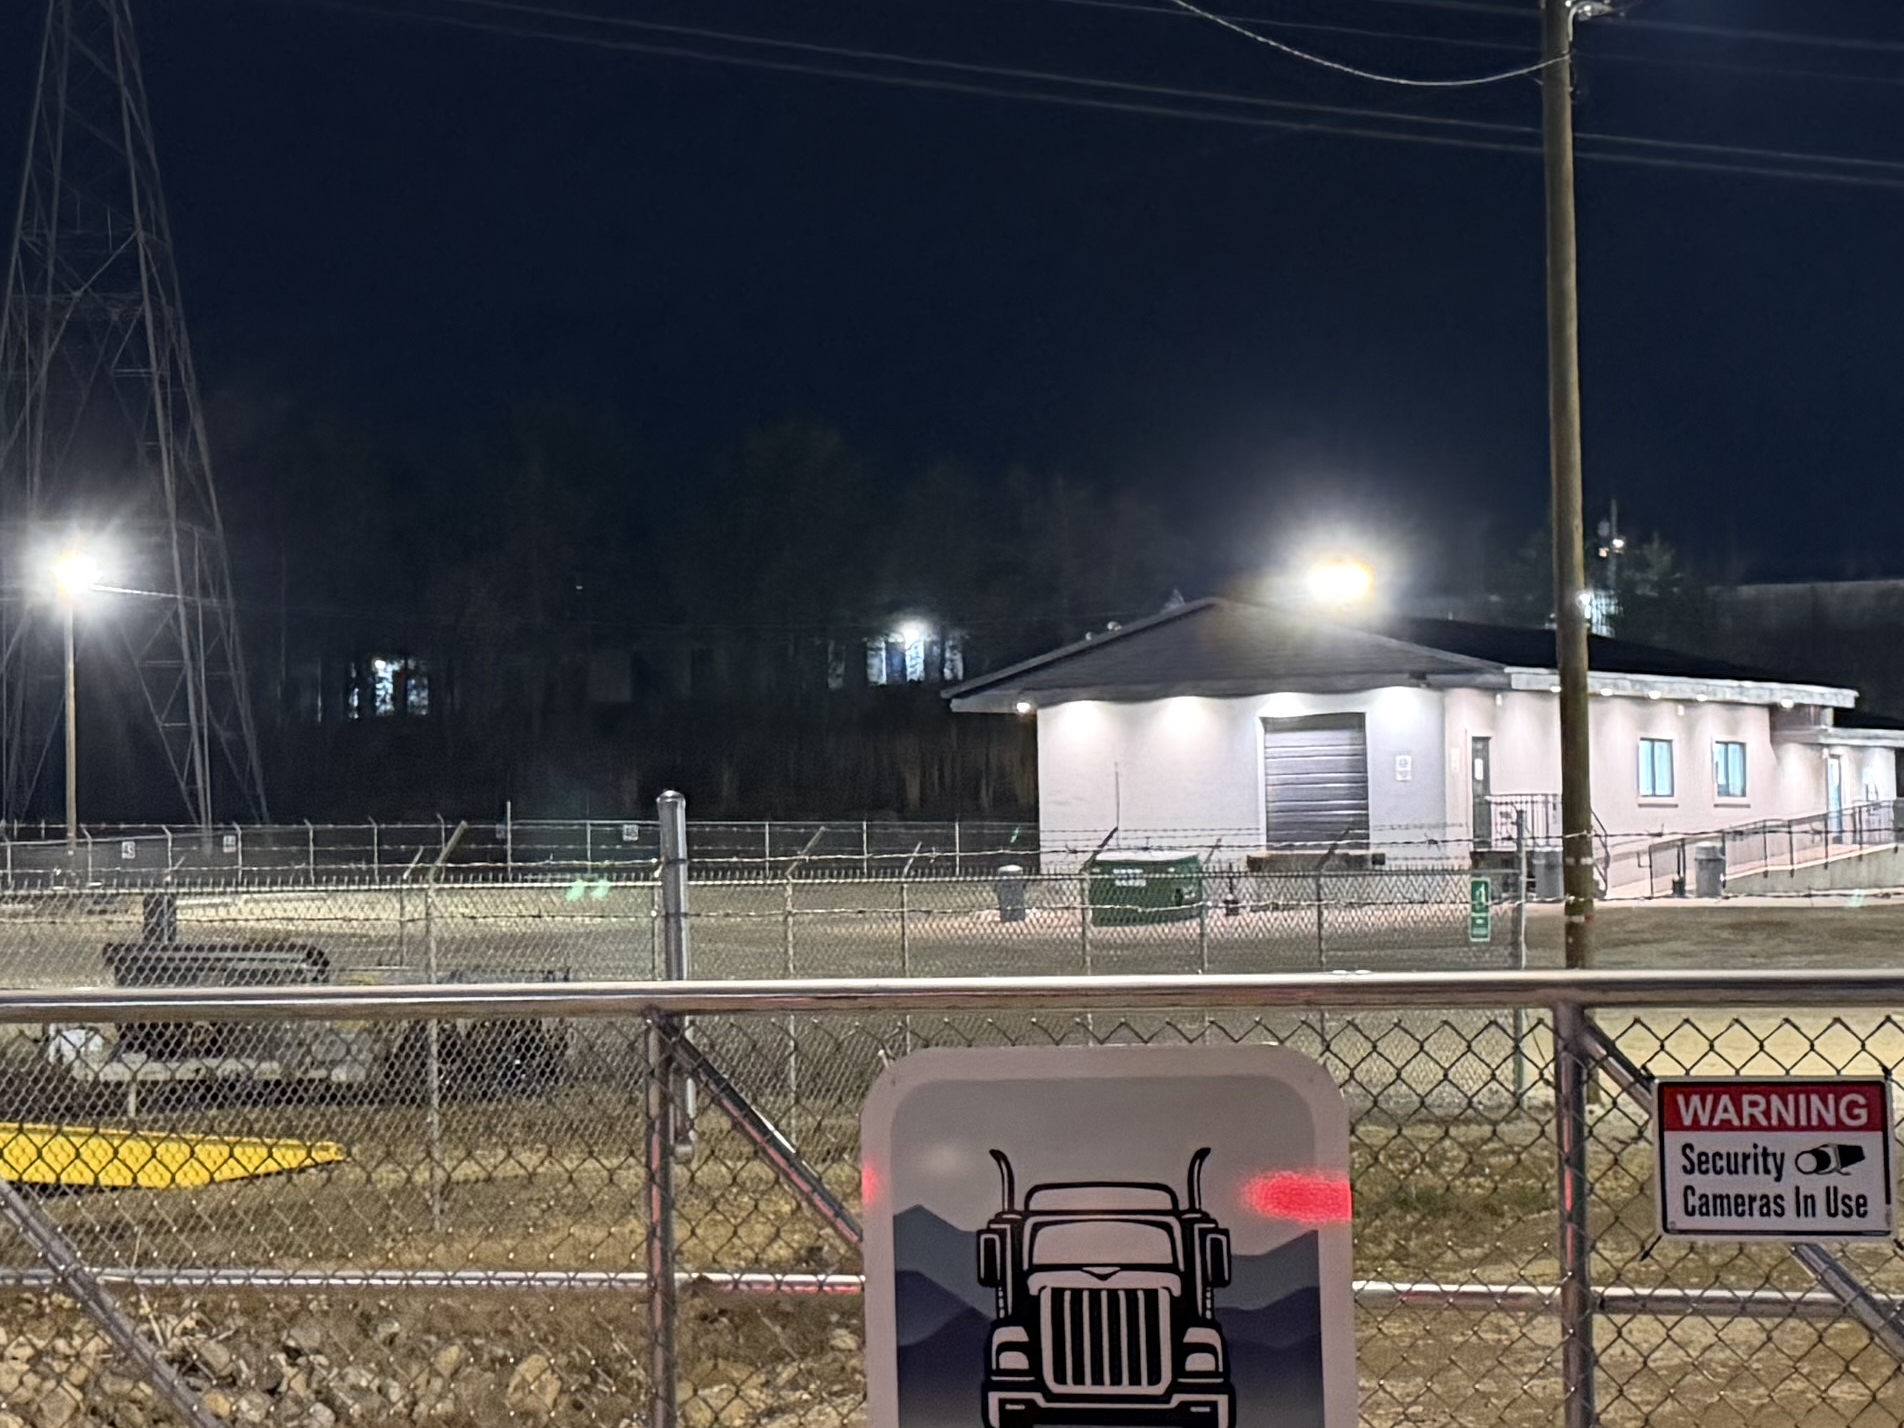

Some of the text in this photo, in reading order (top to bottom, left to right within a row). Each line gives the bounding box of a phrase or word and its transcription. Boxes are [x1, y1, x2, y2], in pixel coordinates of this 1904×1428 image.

[1676, 1093, 1868, 1127] WARNING
[1681, 1142, 1785, 1182] Security
[1683, 1185, 1869, 1218] Cameras In Use
